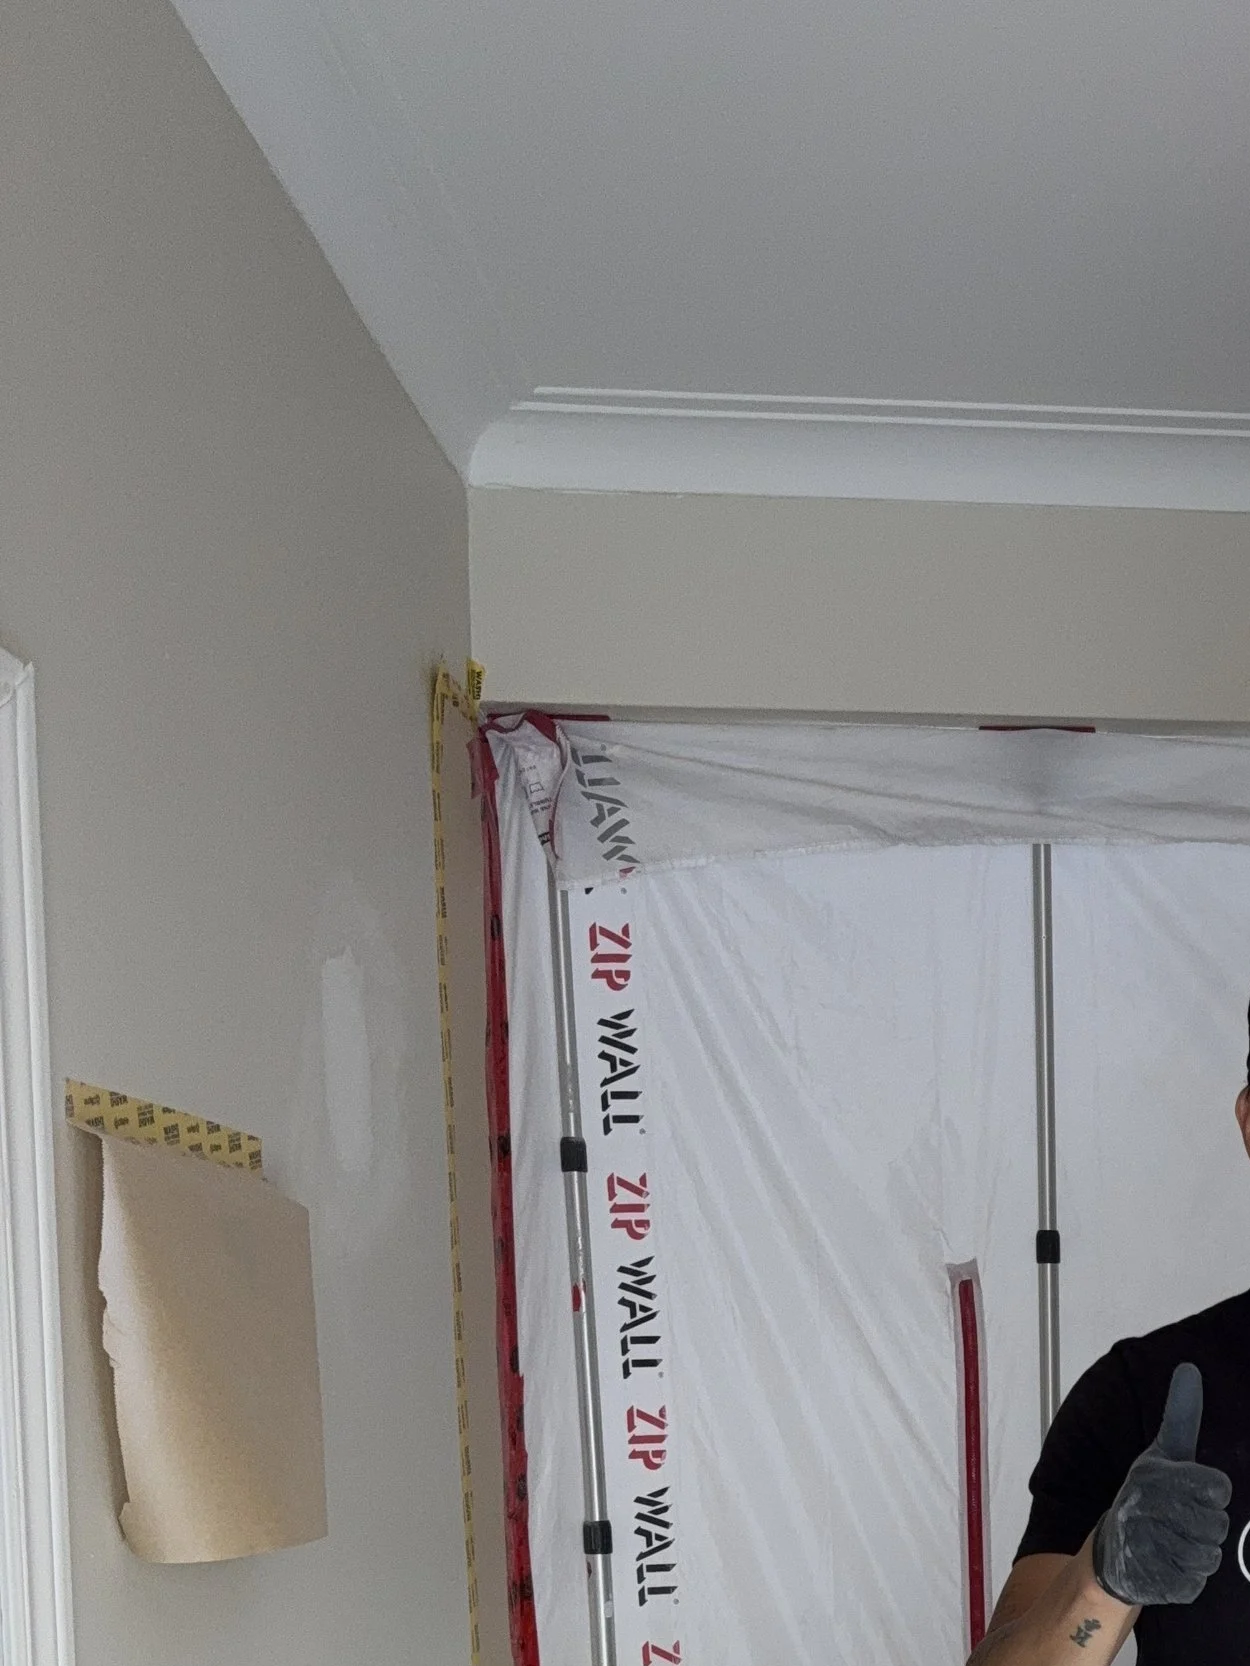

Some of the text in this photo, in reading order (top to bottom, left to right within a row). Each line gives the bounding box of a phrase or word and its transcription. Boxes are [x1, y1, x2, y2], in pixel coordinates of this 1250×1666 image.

[588, 922, 642, 1136] ZIP WALL
[606, 1172, 661, 1380] ZIP WALL
[626, 1404, 677, 1607] ZIP WALL
